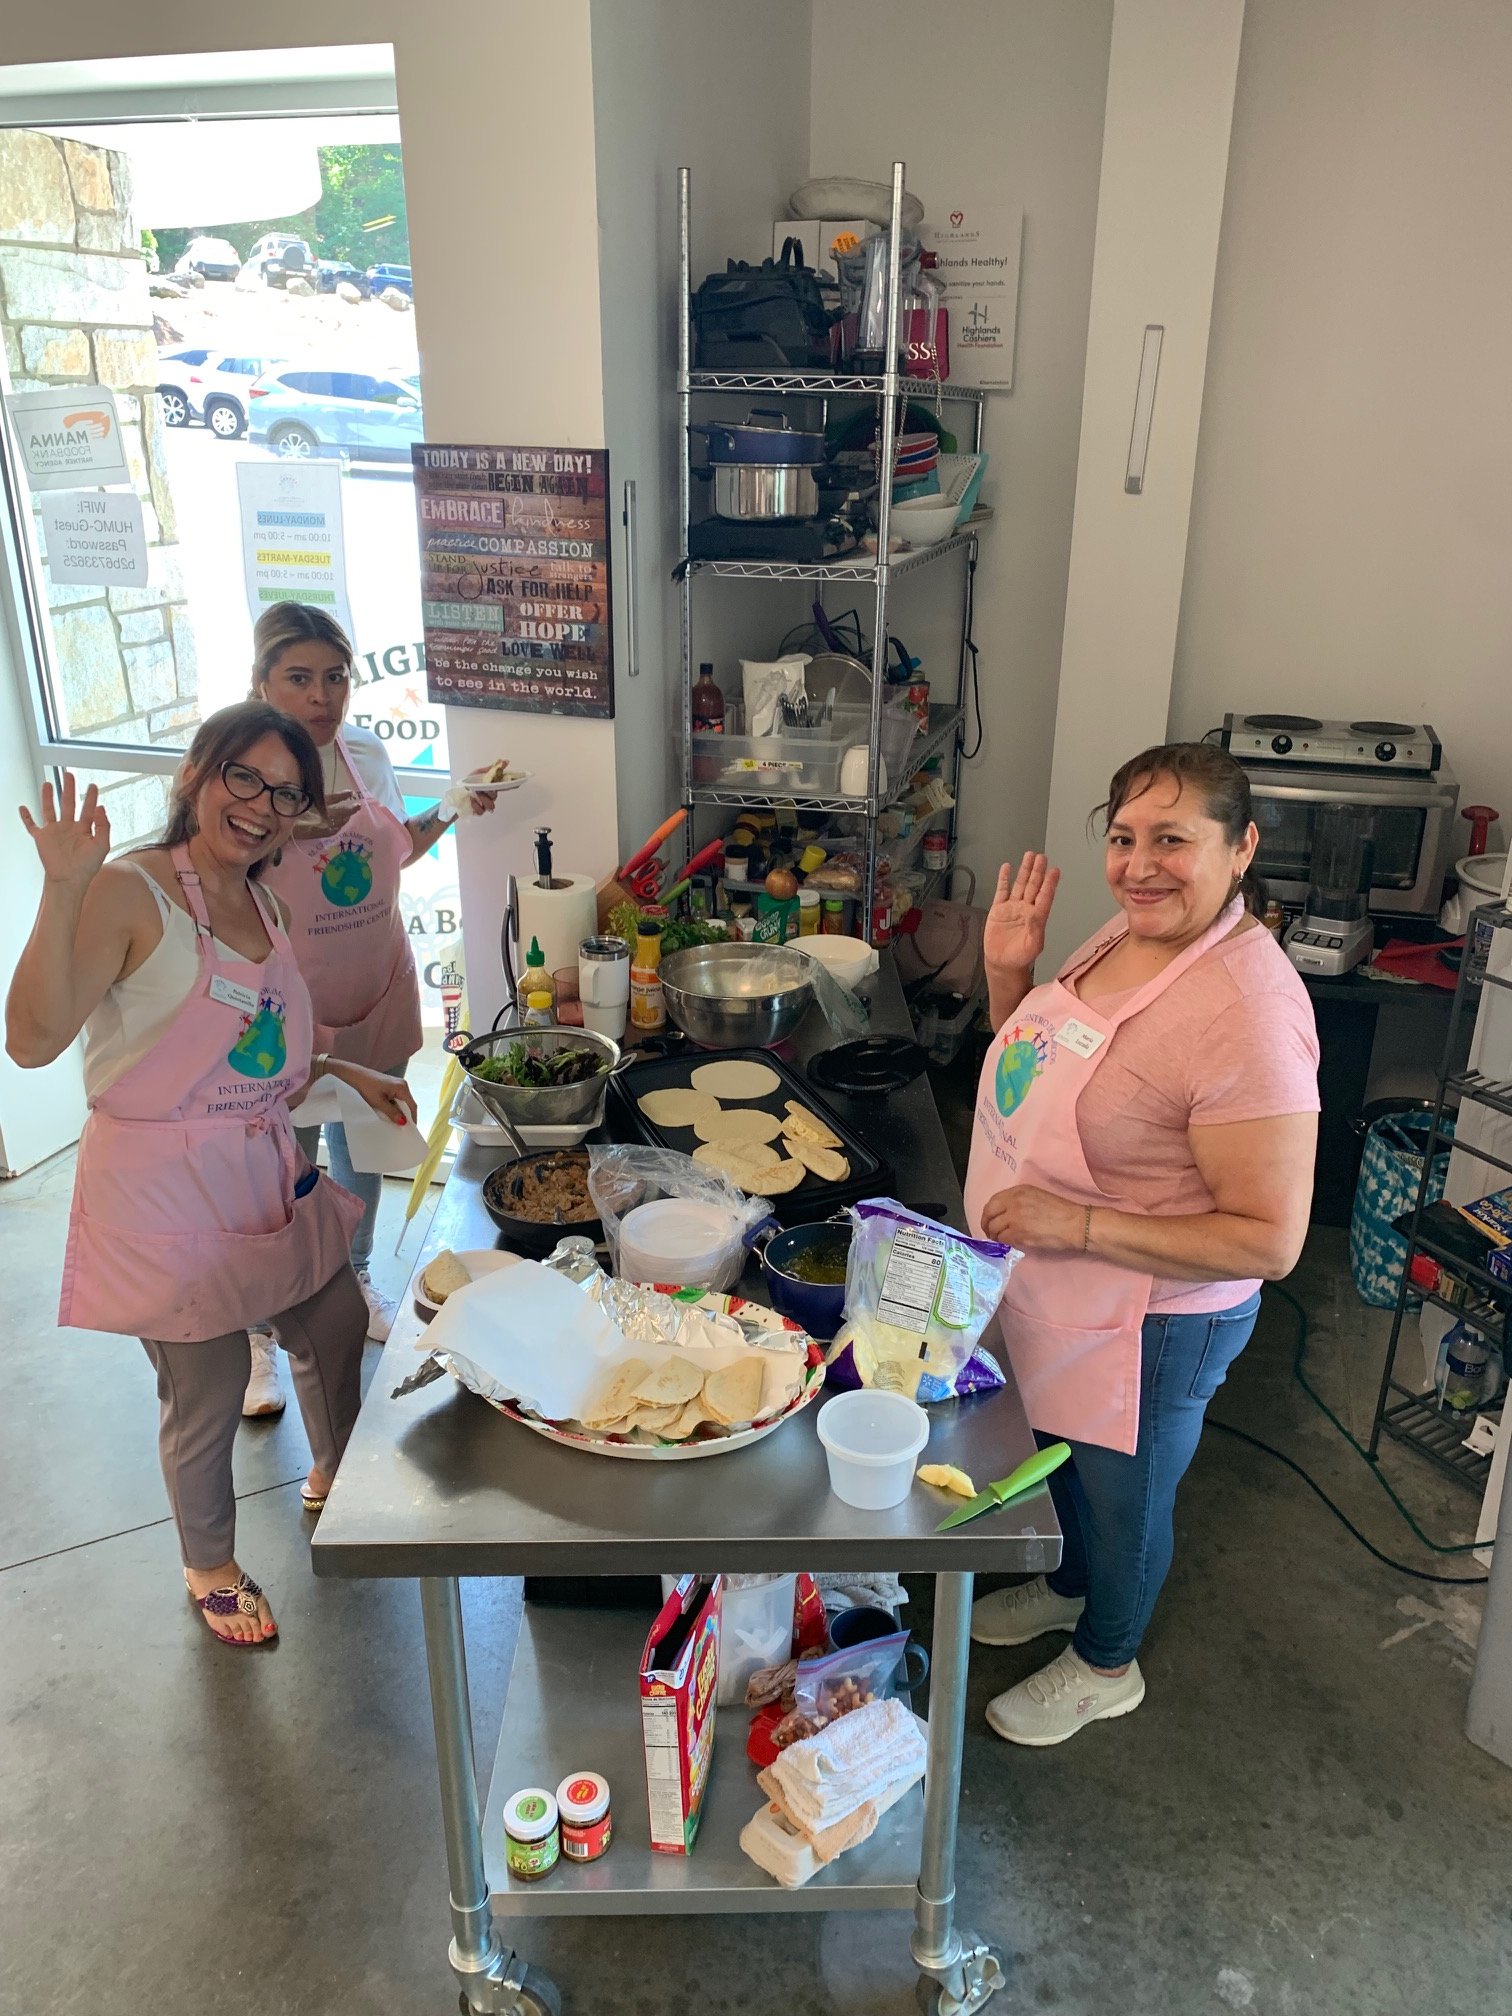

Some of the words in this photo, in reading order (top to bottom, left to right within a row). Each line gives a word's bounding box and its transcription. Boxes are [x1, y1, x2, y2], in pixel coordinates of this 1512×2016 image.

[971, 256, 1008, 269] Healthy!
[962, 326, 1001, 337] Highlands
[963, 333, 996, 342] Cashiers
[422, 449, 469, 469] TODAY
[476, 451, 490, 470] IS
[496, 453, 507, 470] A
[512, 453, 547, 472] NEW
[553, 455, 593, 474] DAY!
[488, 472, 534, 494] BEGIN
[539, 475, 588, 496] AGAIN
[420, 499, 502, 524] EMBRACE
[511, 496, 591, 535] kindness
[427, 536, 478, 551] practice
[478, 536, 593, 559] COMPASSION
[428, 553, 466, 564] STAND
[550, 561, 575, 573] talk
[578, 563, 592, 573] to
[457, 556, 542, 599] justice
[486, 578, 515, 597] ASK
[521, 580, 549, 598] FOR
[554, 582, 593, 601] HELP
[427, 602, 501, 622] LISTEN
[519, 602, 583, 620] OFFER
[519, 621, 586, 642] HOPE
[501, 640, 543, 659] LOVE
[550, 641, 595, 662] WELL
[434, 657, 450, 670] be
[454, 658, 478, 672] the
[482, 660, 532, 677] change
[536, 666, 562, 680] you
[566, 666, 598, 681] wish
[435, 674, 453, 688] to
[457, 677, 483, 690] see
[488, 677, 506, 691] in
[510, 679, 539, 694] the
[545, 683, 598, 700] world.
[353, 714, 441, 741] FOOD
[307, 918, 366, 936] FRIENDSHIP
[897, 1228, 926, 1243] Nutrition
[892, 1249, 915, 1260] Calories
[931, 1258, 941, 1267] 80
